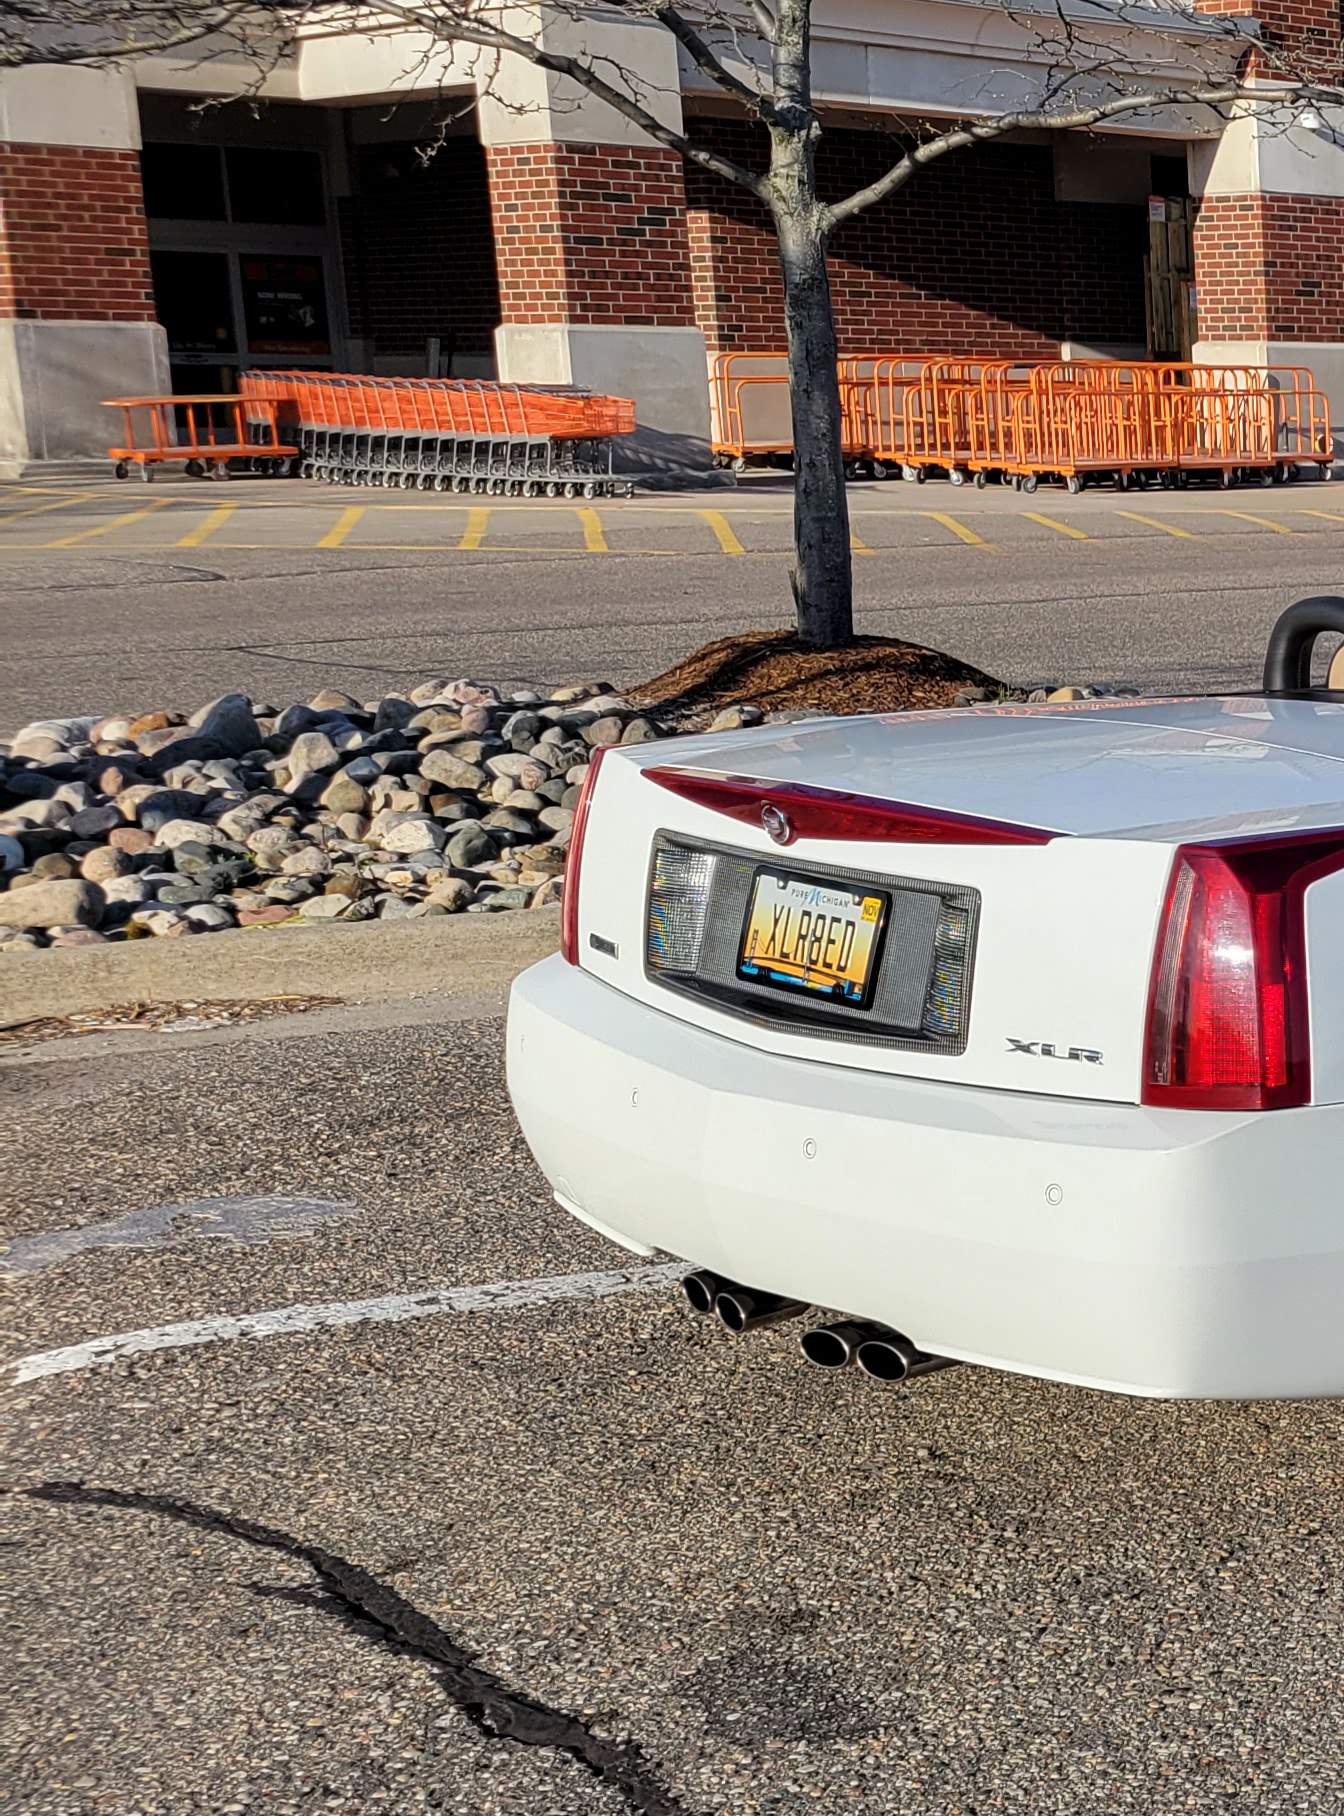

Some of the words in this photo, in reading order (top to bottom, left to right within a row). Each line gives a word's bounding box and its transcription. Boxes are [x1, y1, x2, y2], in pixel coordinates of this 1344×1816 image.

[791, 888, 808, 901] PURE
[801, 888, 849, 908] MICHIGAN
[1005, 1038, 1104, 1065] XLR
